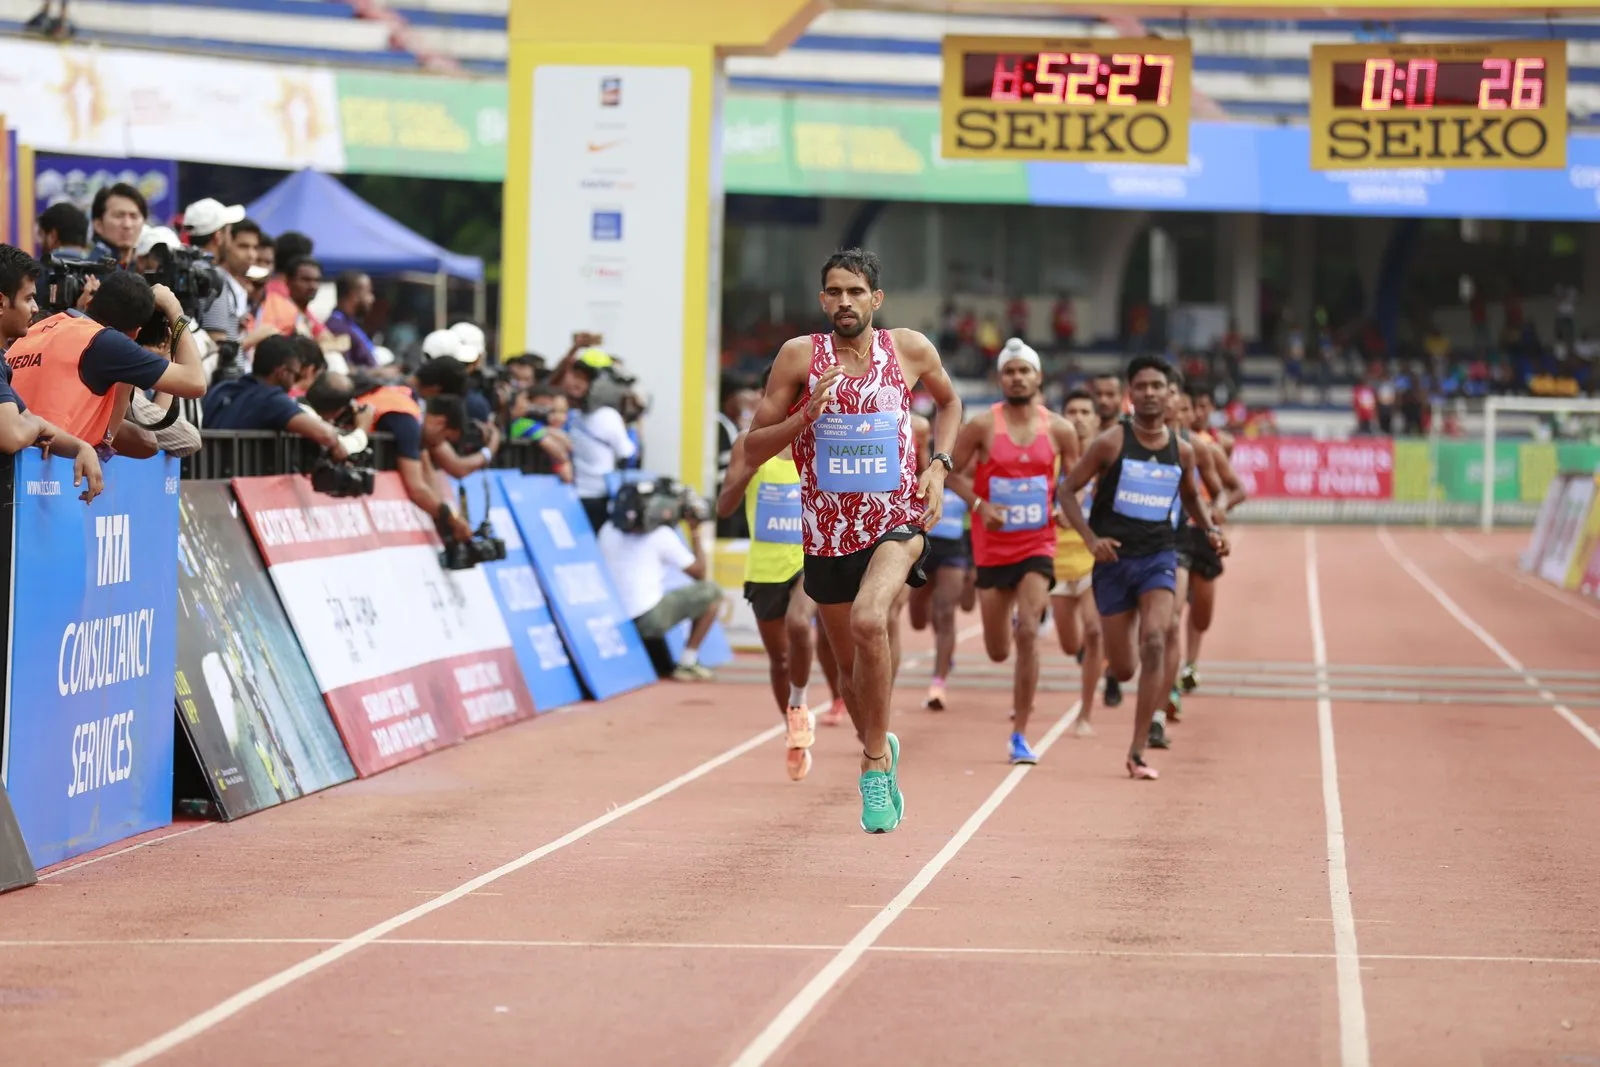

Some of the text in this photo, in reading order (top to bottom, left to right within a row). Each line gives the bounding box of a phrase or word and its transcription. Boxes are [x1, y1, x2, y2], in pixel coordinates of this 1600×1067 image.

[1478, 57, 1545, 110] 26
[955, 108, 1171, 155] SEIKO
[1328, 116, 1548, 160] SEIKO
[7, 352, 42, 370] MEDIA
[829, 444, 884, 457] NAVEEN
[829, 457, 887, 475] ELITE
[767, 517, 802, 531] ANI
[95, 514, 131, 587] TATA
[58, 608, 154, 696] CONSULTANCY
[67, 709, 134, 798] SERVICES
